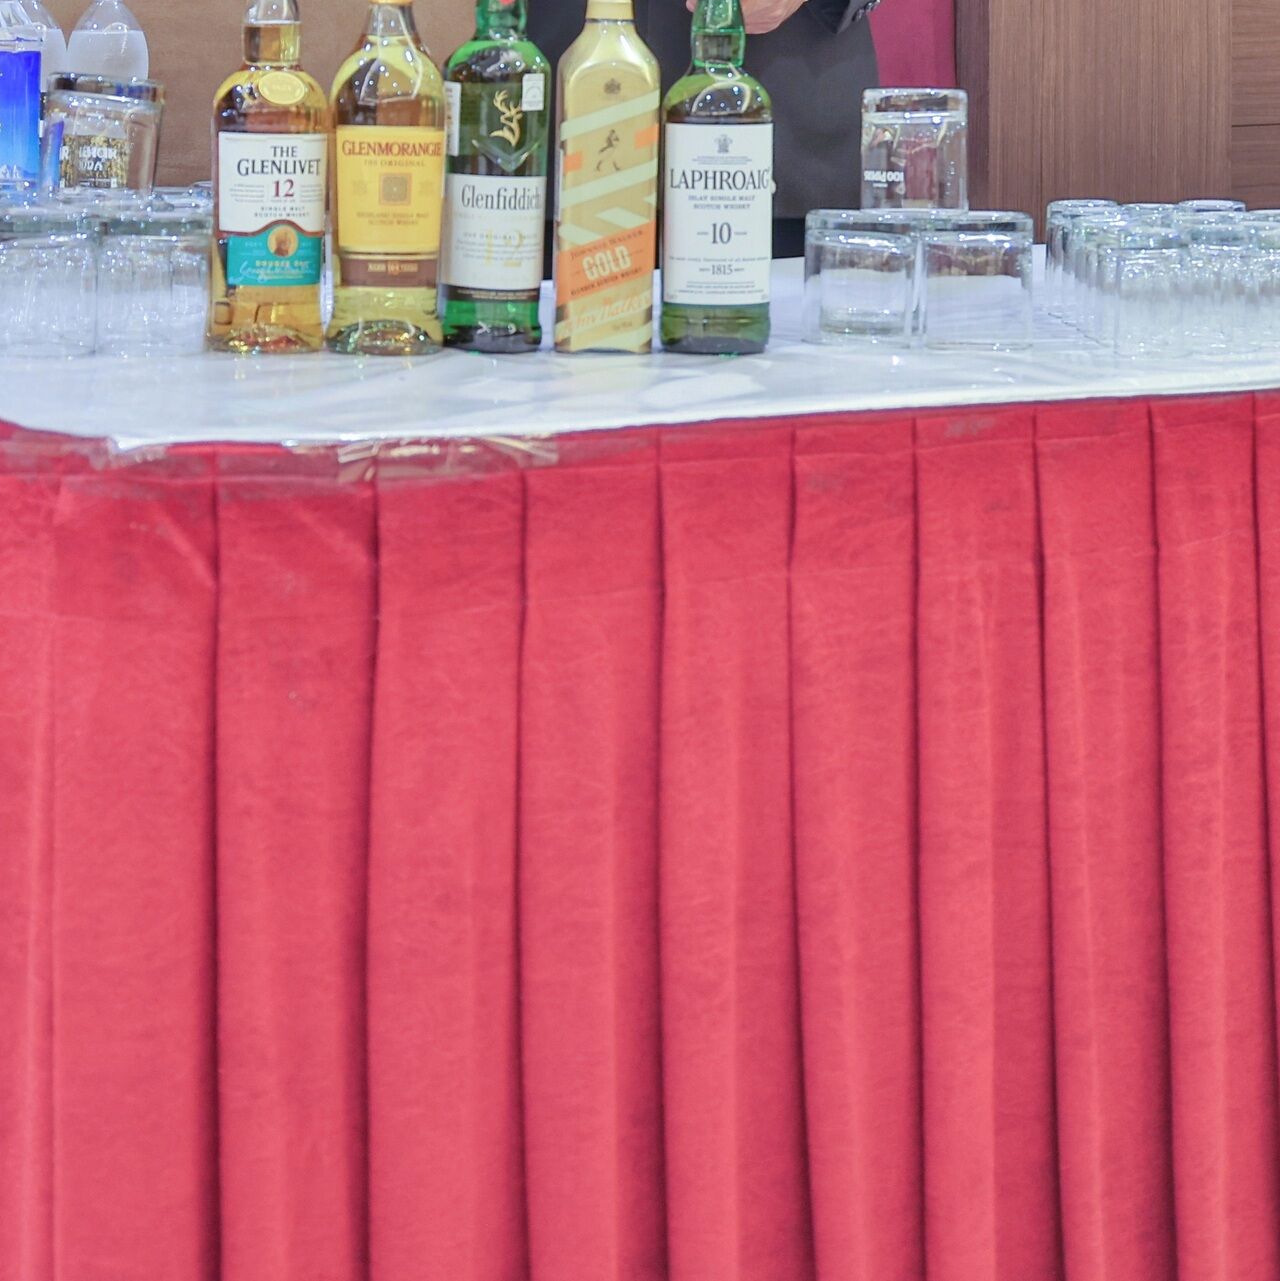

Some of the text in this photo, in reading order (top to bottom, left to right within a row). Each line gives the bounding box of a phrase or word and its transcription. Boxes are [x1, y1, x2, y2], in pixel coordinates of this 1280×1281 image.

[270, 146, 298, 157] THE
[342, 140, 442, 157] GLENMORANGIE
[237, 158, 321, 176] GLENLIVET
[273, 179, 295, 197] 12
[670, 168, 769, 191] LAPHROAIG
[461, 184, 541, 211] Glenfiddich
[711, 222, 732, 244] 10
[582, 245, 632, 281] GOLD
[711, 264, 733, 276] 1815
